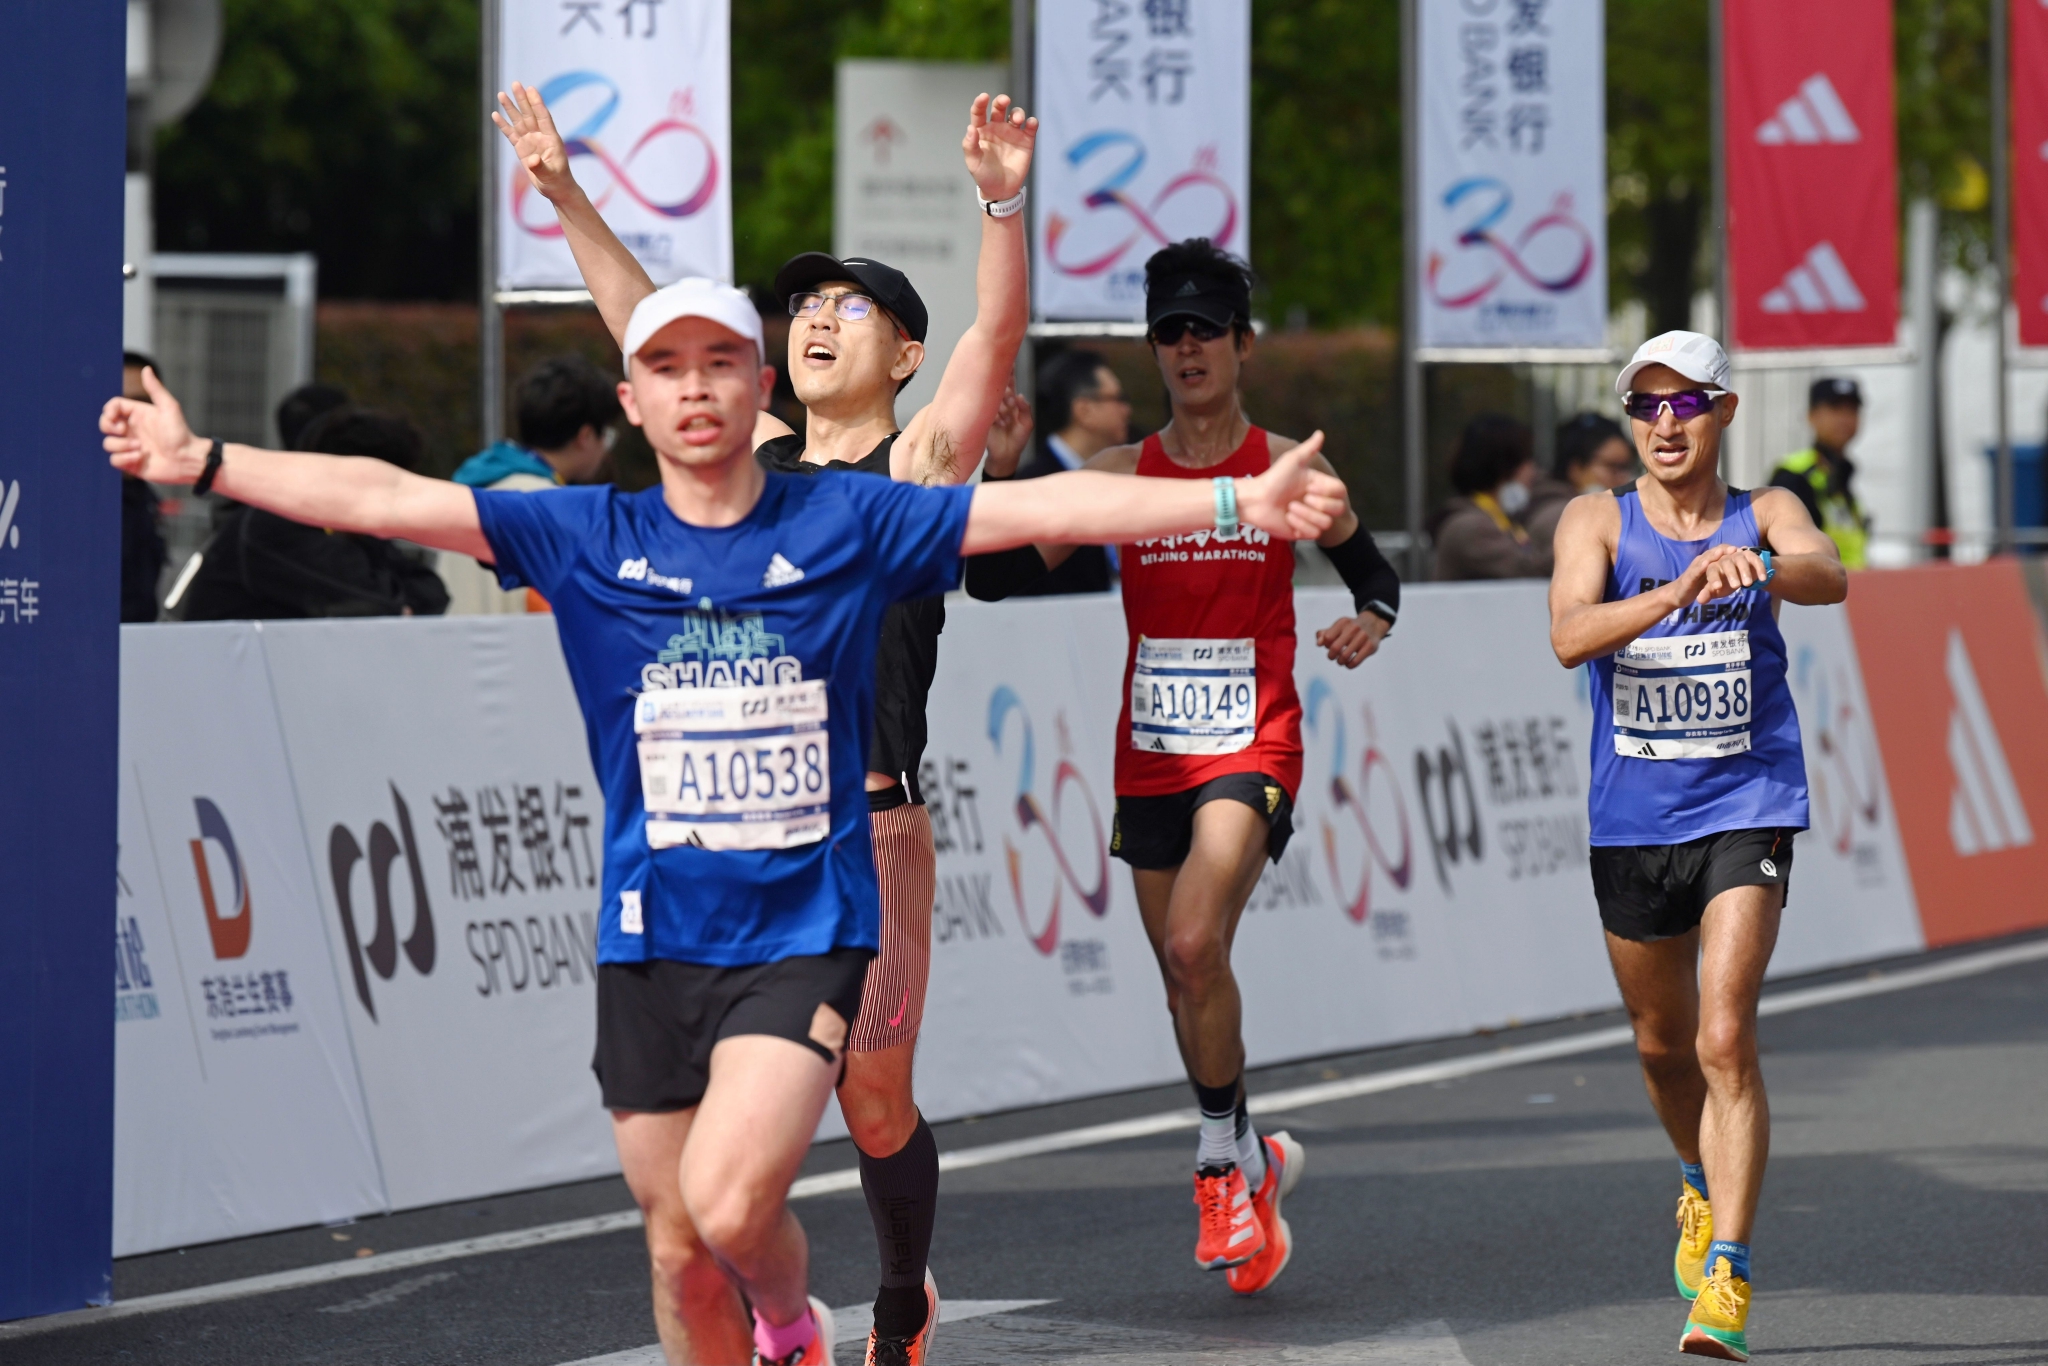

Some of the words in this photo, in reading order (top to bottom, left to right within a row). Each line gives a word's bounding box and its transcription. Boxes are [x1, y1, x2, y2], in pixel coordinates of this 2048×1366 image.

[1141, 551, 1189, 566] BEIJING
[1193, 549, 1266, 563] MARATHON
[1151, 683, 1251, 720] A10149
[1635, 677, 1749, 723] A10938
[678, 743, 823, 802] A10538
[432, 779, 597, 901] 浦发银行
